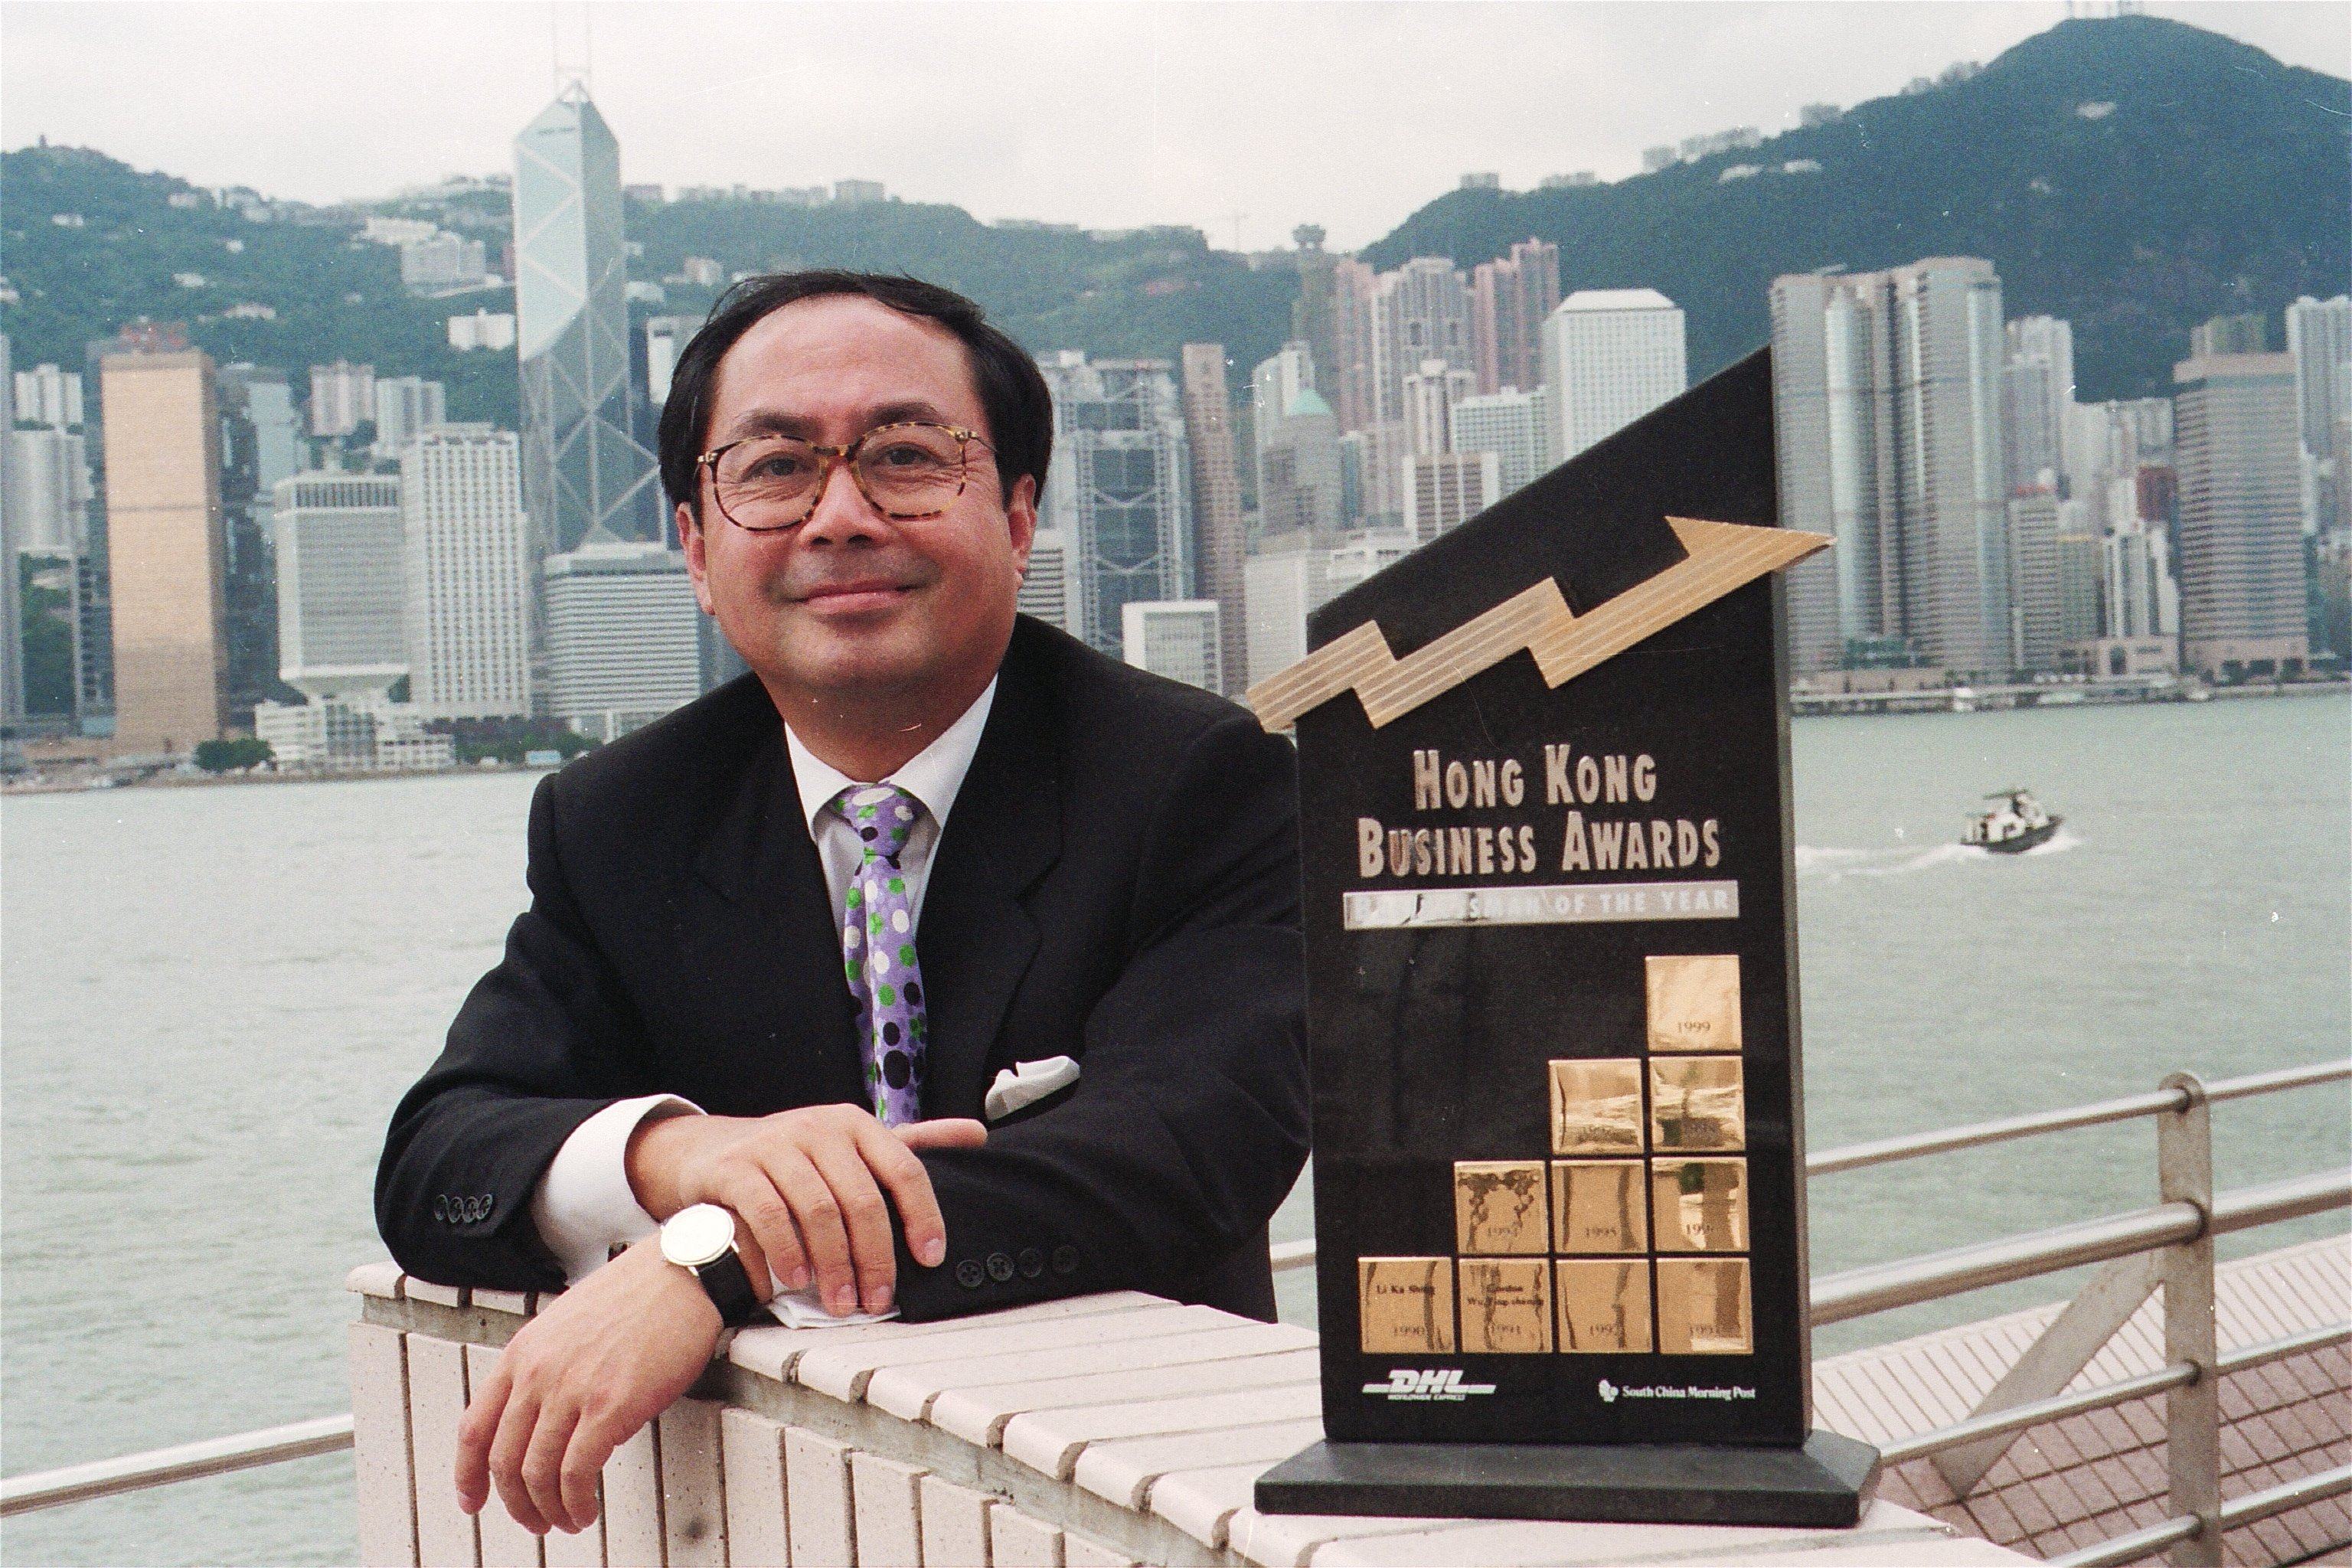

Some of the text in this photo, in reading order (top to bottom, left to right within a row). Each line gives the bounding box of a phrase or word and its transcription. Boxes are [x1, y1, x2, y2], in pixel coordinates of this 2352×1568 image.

[1413, 743, 1657, 810] HONG KONG
[1357, 810, 1720, 878] BUSINESS AWARDS
[1554, 893, 1586, 915] OF
[1599, 891, 1647, 913] THE
[1661, 889, 1729, 912] YEAR
[1388, 1370, 1464, 1394] DHL
[1622, 1385, 1756, 1402] South China Morning Post
